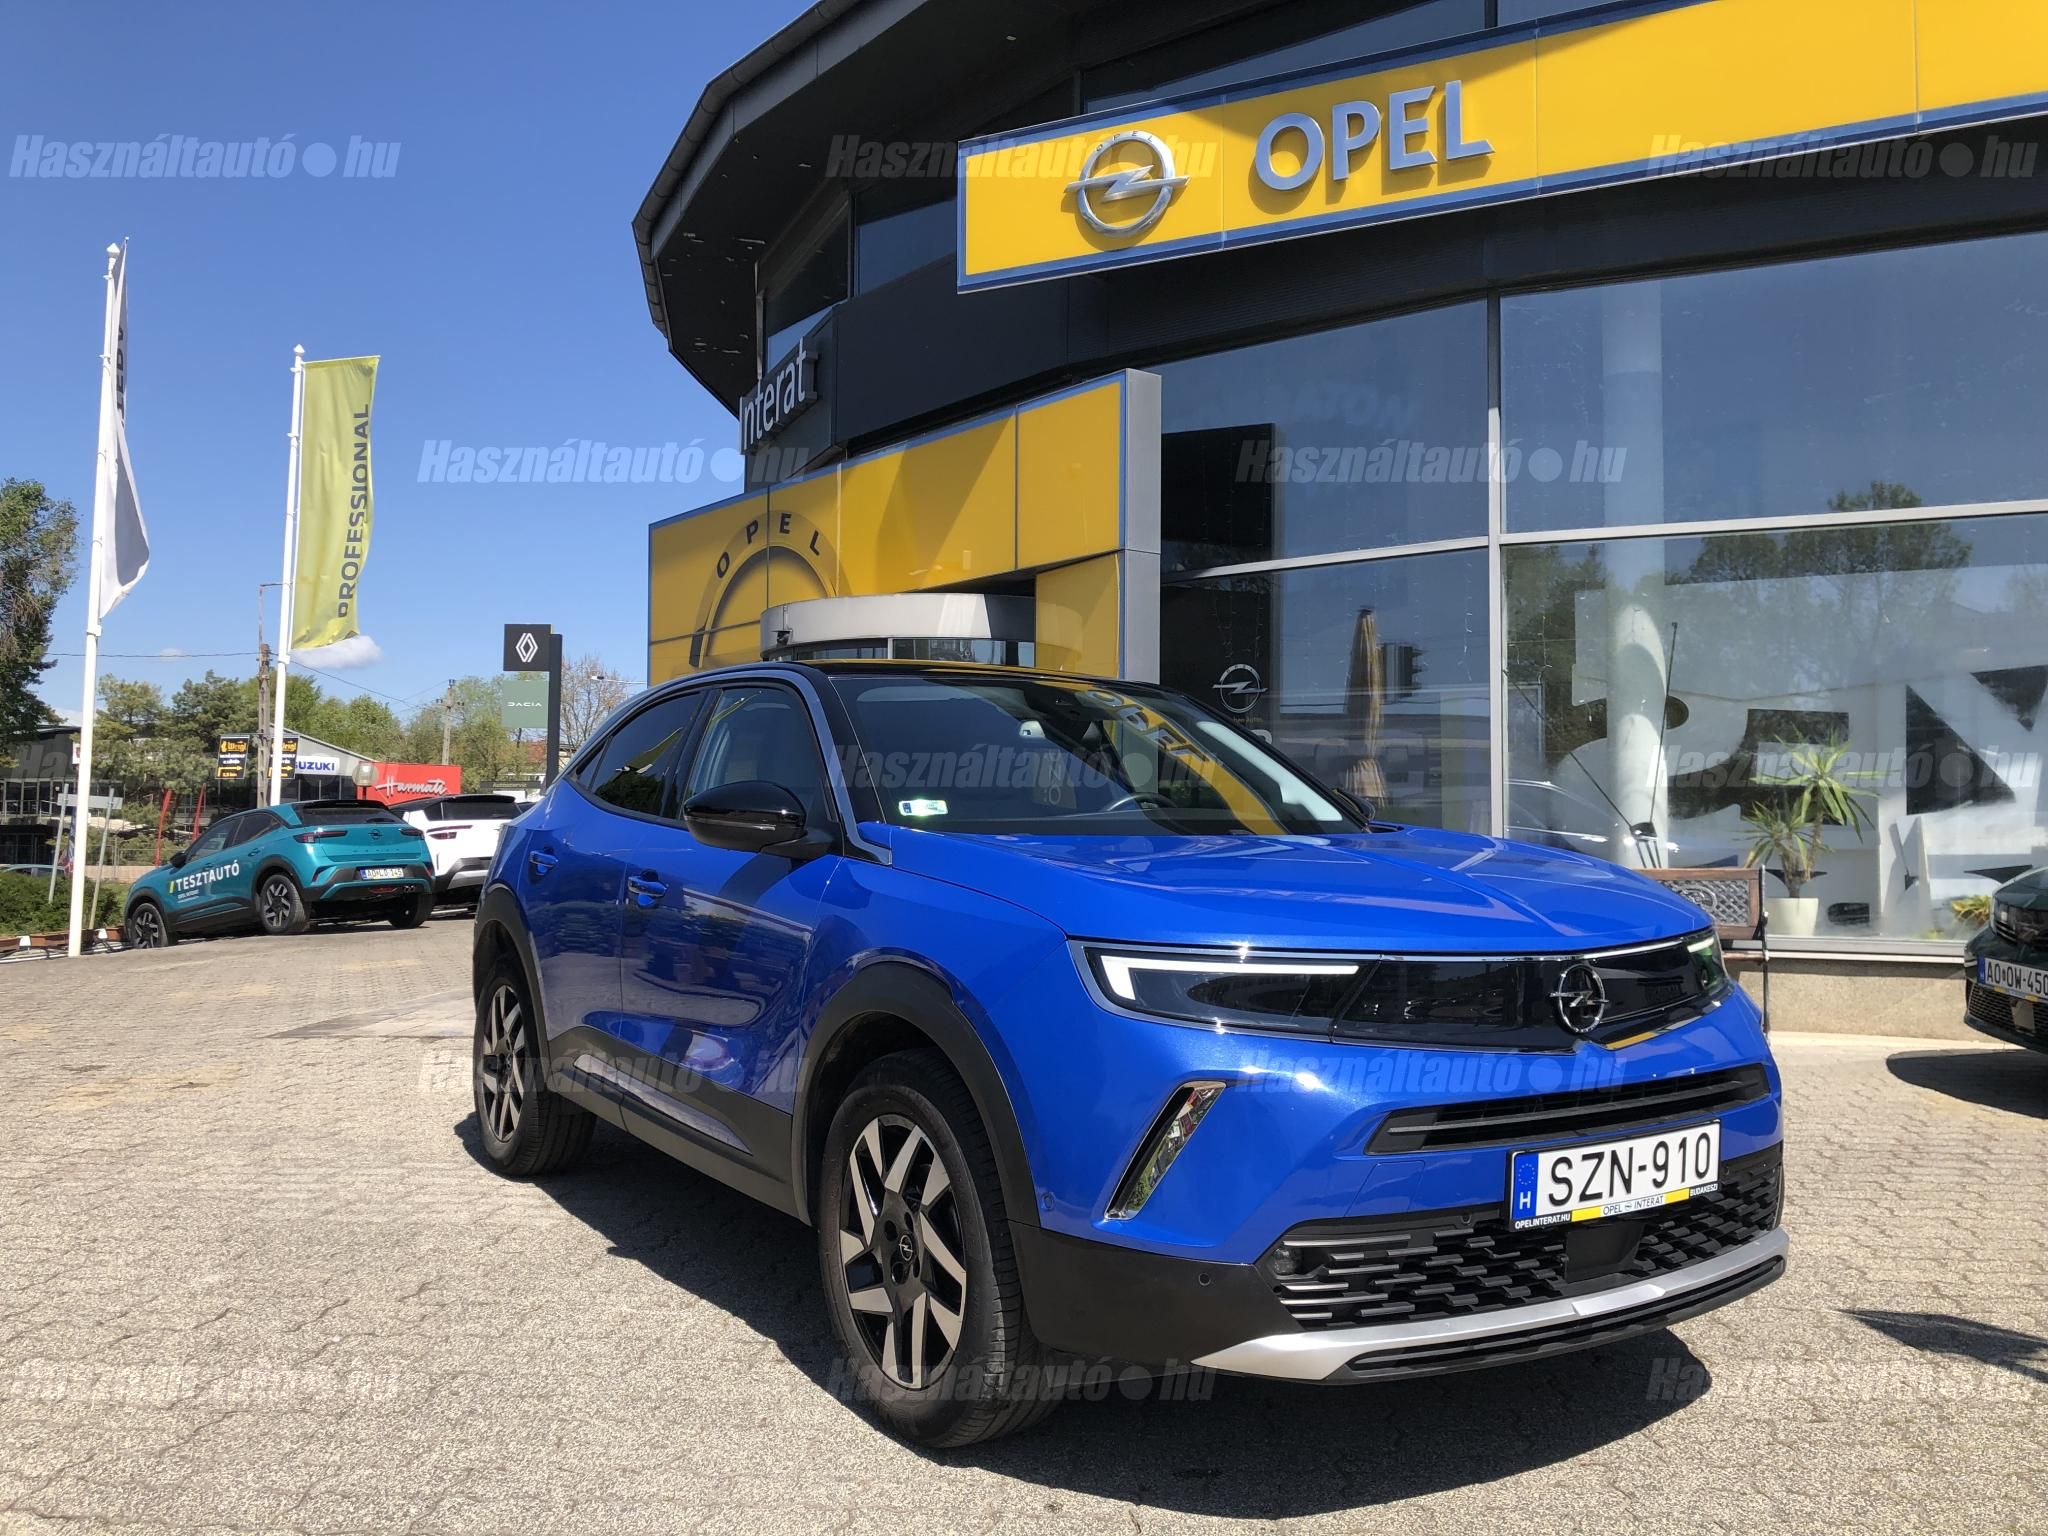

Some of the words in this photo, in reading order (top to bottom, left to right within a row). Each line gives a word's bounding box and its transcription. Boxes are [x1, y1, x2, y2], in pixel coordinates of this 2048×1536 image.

[1254, 80, 1496, 191] OPEL
[739, 336, 808, 455] Interat
[337, 403, 369, 618] PROFESSIONAL
[716, 512, 820, 579] OPEL
[176, 859, 240, 892] TESZTAUTÓ
[1519, 1190, 1532, 1210] H
[1548, 1132, 1712, 1207] SZN-910
[1514, 1213, 1572, 1230] OPELINTERAT.HU
[1602, 1204, 1623, 1216] OPEL
[1634, 1195, 1664, 1209] INTERAT
